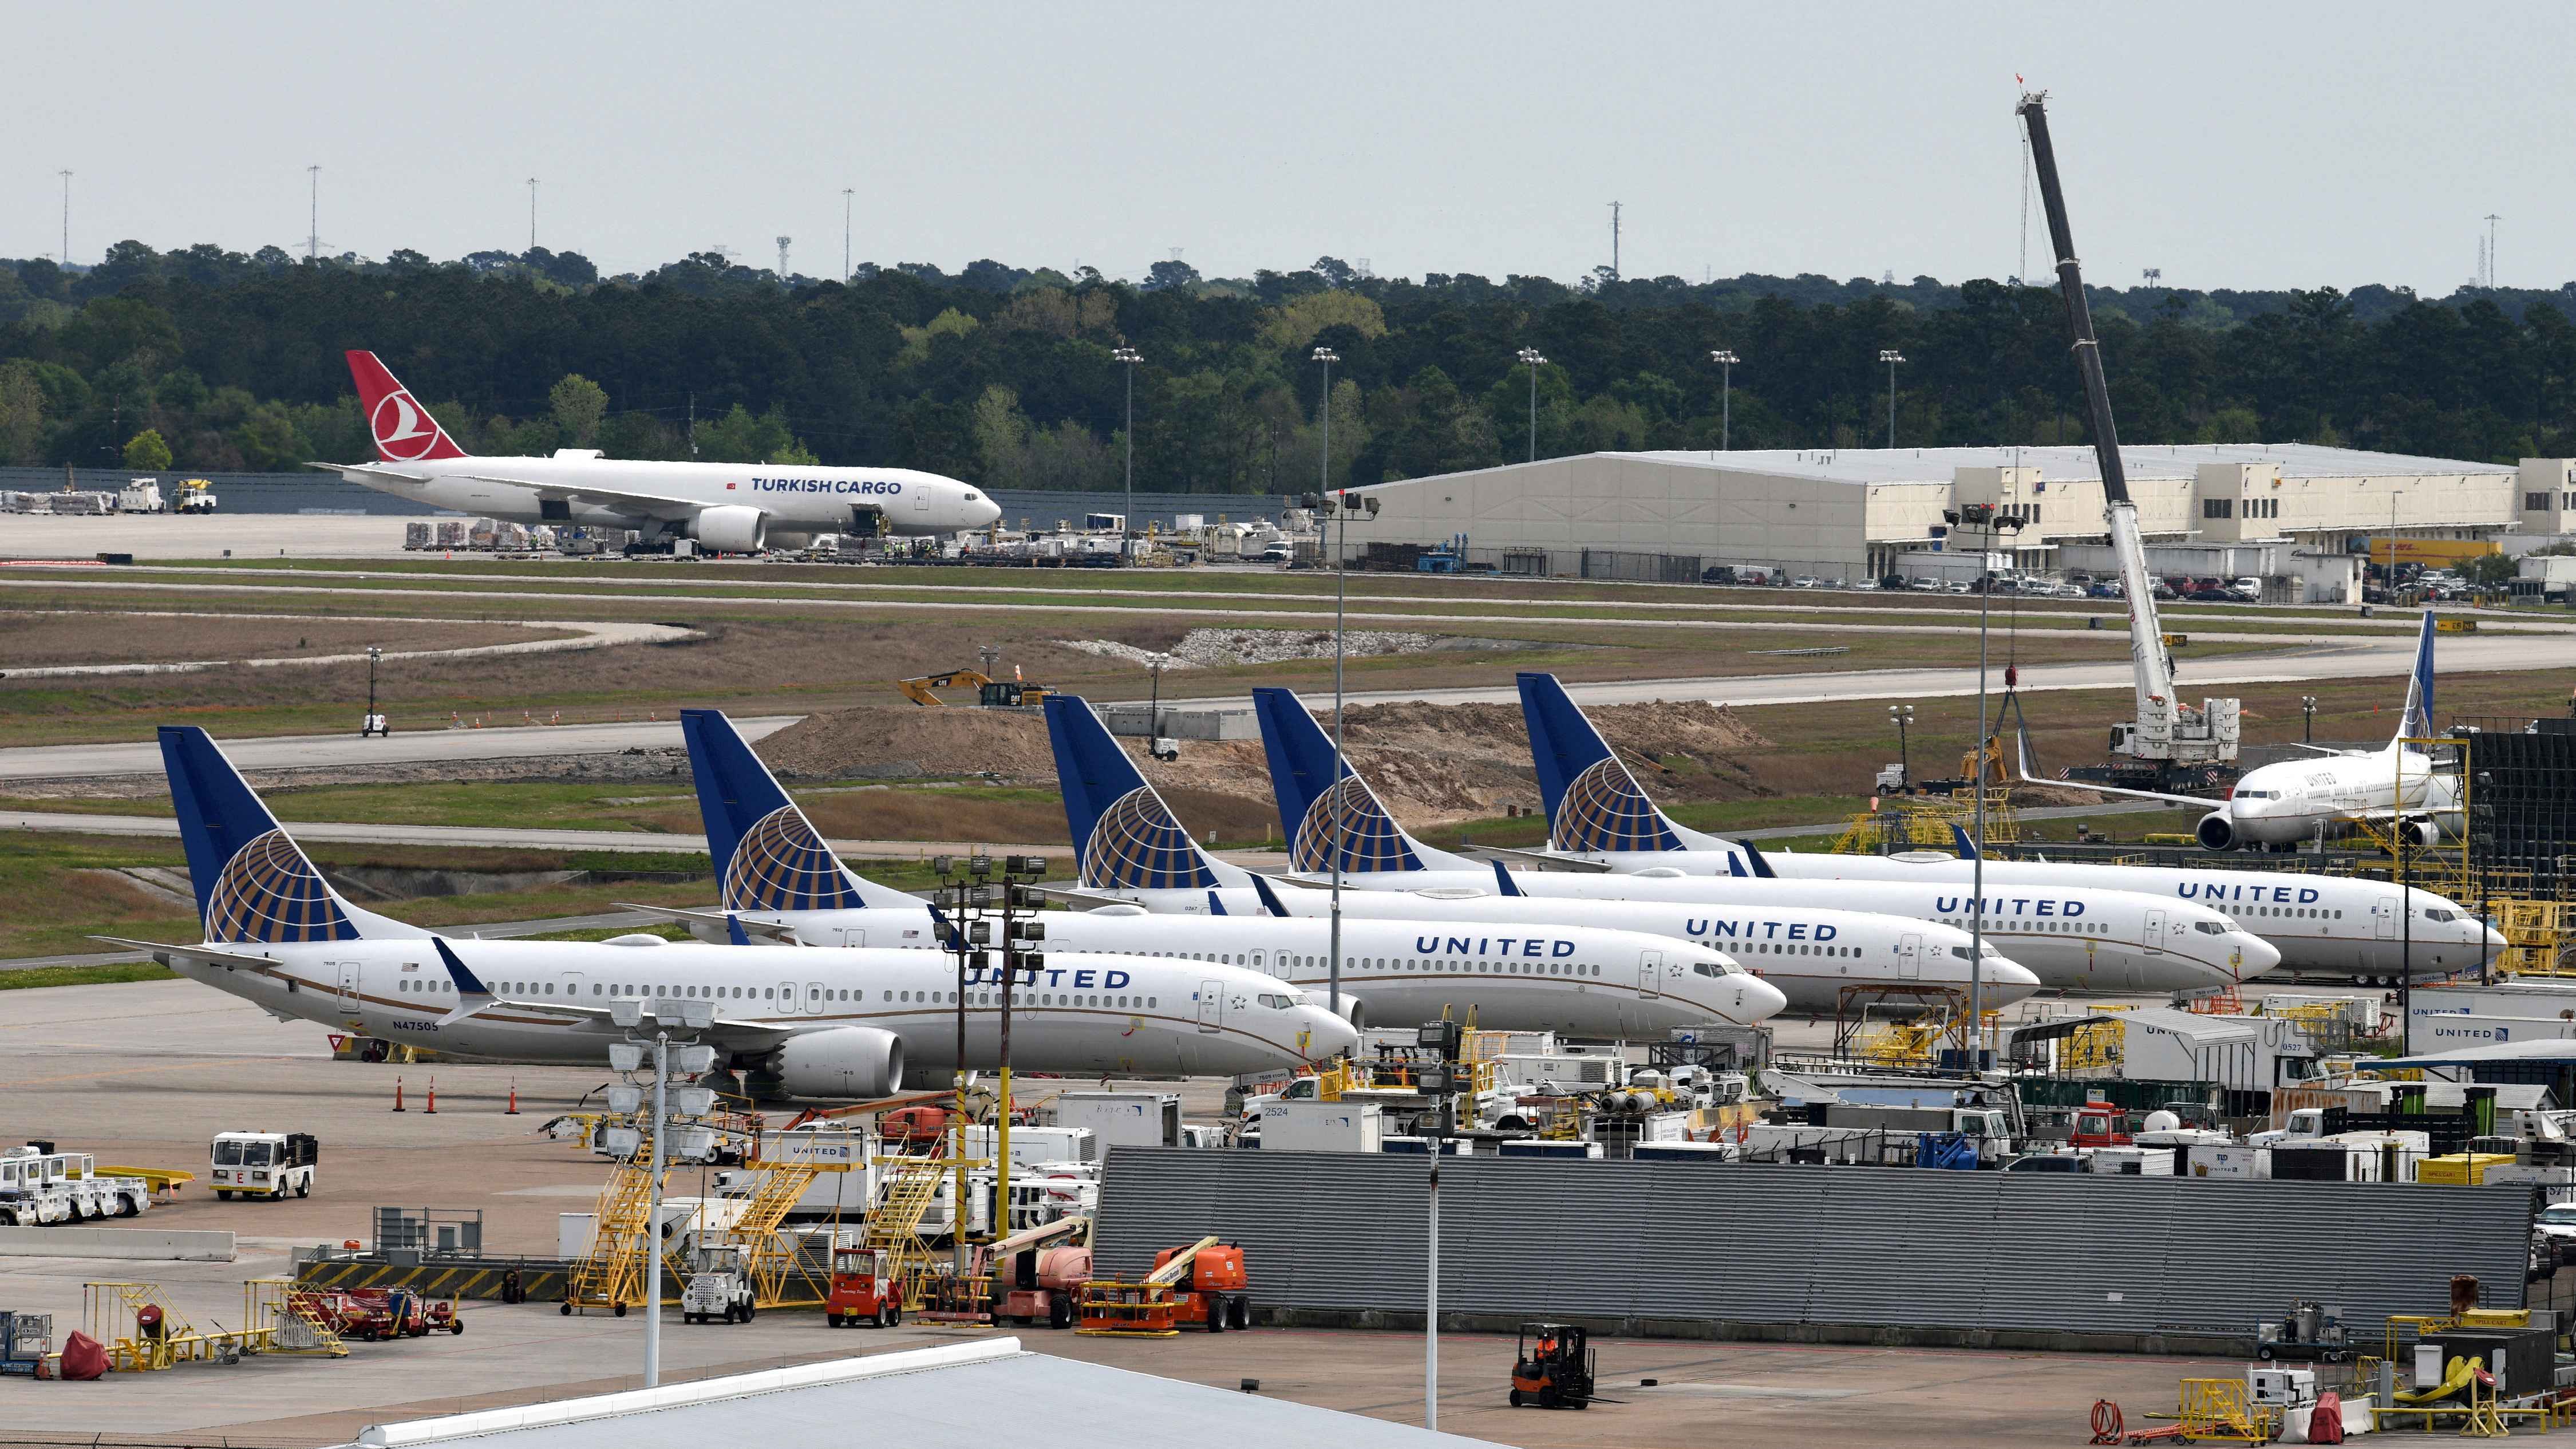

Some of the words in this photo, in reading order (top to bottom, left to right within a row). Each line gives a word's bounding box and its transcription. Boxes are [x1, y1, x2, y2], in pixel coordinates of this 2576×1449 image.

[752, 478, 832, 493] TURKISH
[835, 481, 902, 494] CARGO
[2304, 772, 2336, 787] UNITED
[2178, 882, 2319, 903] UNITED
[1936, 897, 2085, 917] UNITED
[1686, 918, 1837, 941] UNITED
[1416, 937, 1575, 957] UNITED
[962, 967, 1131, 989] UNITED
[393, 1020, 438, 1032] N47505
[2436, 1028, 2491, 1038] UNITED
[2282, 1043, 2302, 1051] 0527
[1265, 1107, 1288, 1116] 2524
[793, 1147, 836, 1155] UNITED
[237, 1172, 243, 1184] E
